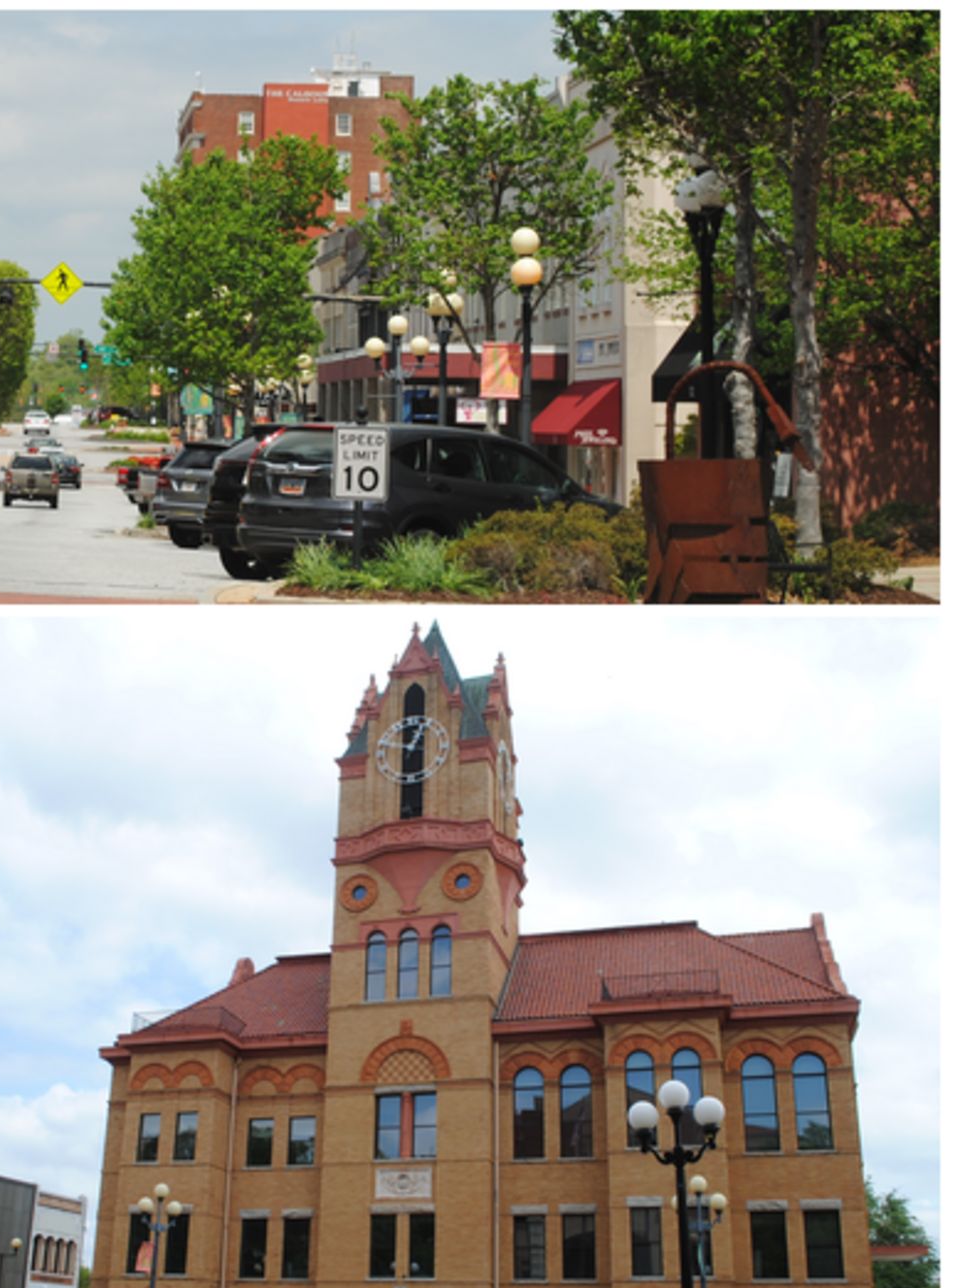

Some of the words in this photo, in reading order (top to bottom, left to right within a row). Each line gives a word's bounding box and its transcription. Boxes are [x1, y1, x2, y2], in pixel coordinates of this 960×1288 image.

[340, 433, 385, 446] SPEED
[343, 450, 379, 460] LIMIT
[344, 466, 379, 492] 10
